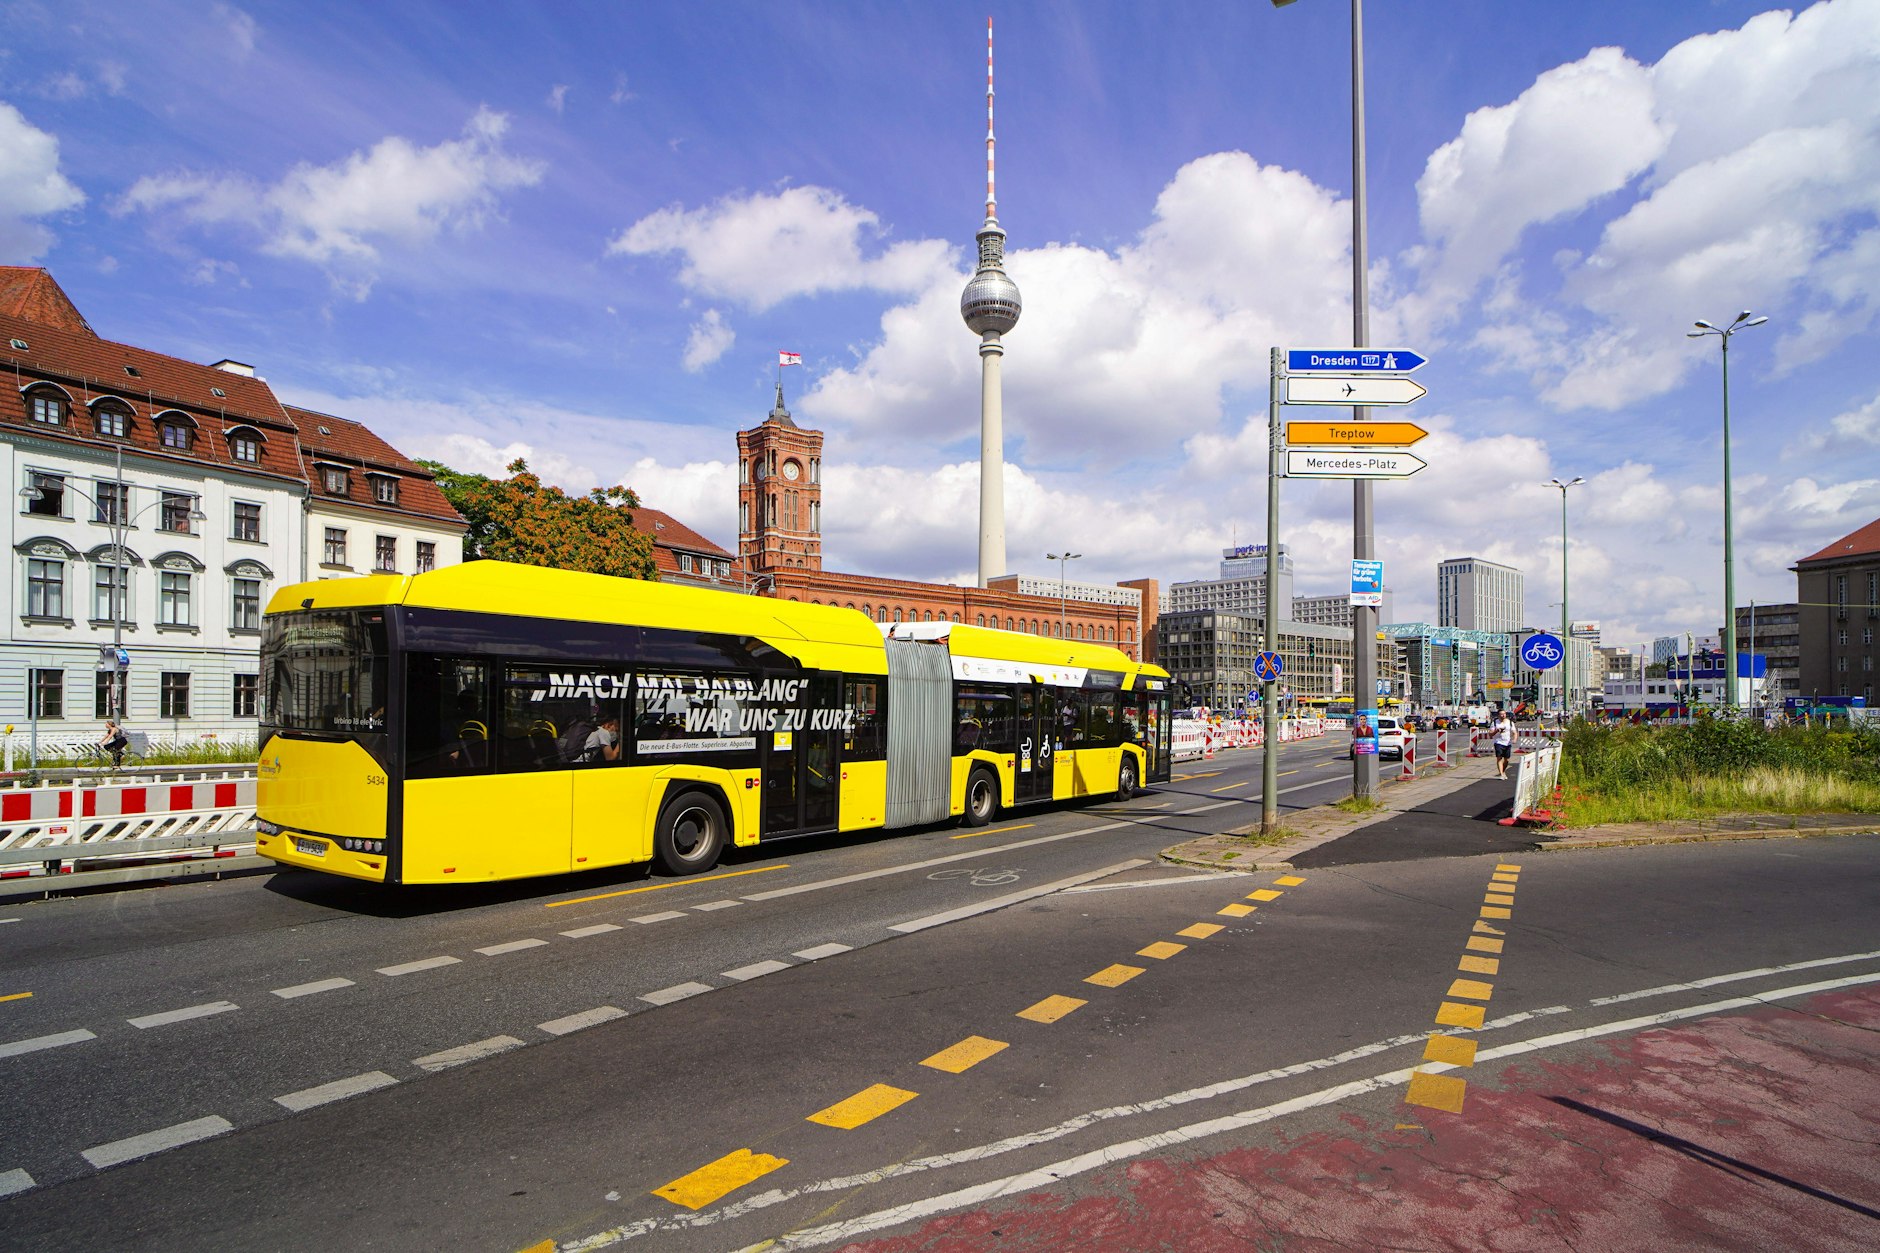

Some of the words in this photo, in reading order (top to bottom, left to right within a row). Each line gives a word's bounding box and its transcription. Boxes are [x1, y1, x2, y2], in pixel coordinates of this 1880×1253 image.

[1310, 355, 1358, 366] Dresden
[1329, 429, 1375, 439] Treptow
[1306, 458, 1397, 469] Mercedes-Platz
[1235, 544, 1254, 555] park
[636, 676, 687, 700] MAL
[333, 717, 353, 725] Urbino
[353, 717, 360, 725] 18
[684, 707, 733, 733] WAR
[739, 708, 778, 732] UNS
[782, 708, 807, 731] ZU
[810, 708, 856, 731] KURZ.
[639, 743, 650, 751] Die
[650, 743, 665, 751] neue
[666, 742, 700, 750] E-Bus-Flotte.
[701, 741, 728, 750] Superleise.
[729, 740, 753, 749] Abgasfrei.
[367, 775, 385, 786] 5434
